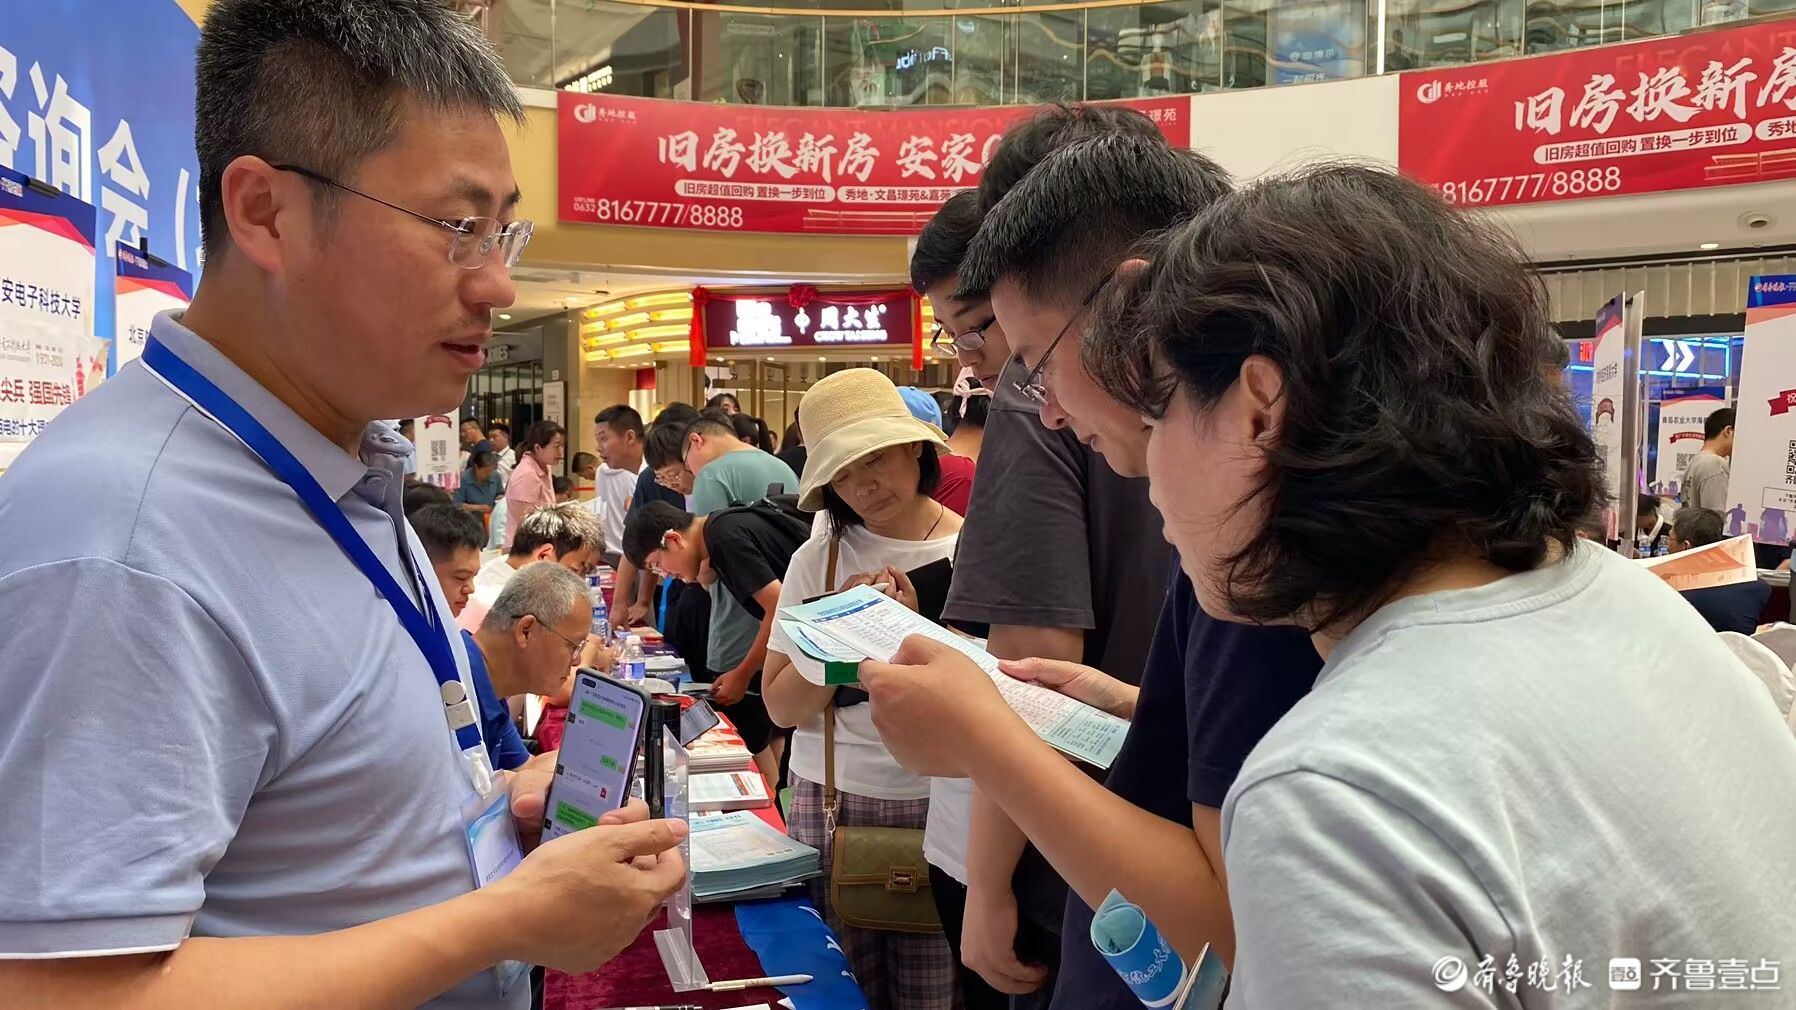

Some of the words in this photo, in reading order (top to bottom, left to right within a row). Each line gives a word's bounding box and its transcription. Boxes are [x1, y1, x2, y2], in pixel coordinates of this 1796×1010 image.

[658, 127, 880, 183] 旧房换新房
[1545, 139, 1637, 161] 旧房超值回购
[1640, 127, 1738, 151] 置换一步到位
[684, 182, 754, 198] 旧房超值回购
[757, 186, 826, 200] 置换一步到位
[1442, 166, 1621, 205] 8167777/8888
[597, 198, 743, 228] 8167777/8888
[2, 277, 80, 319] 安电子科技大学
